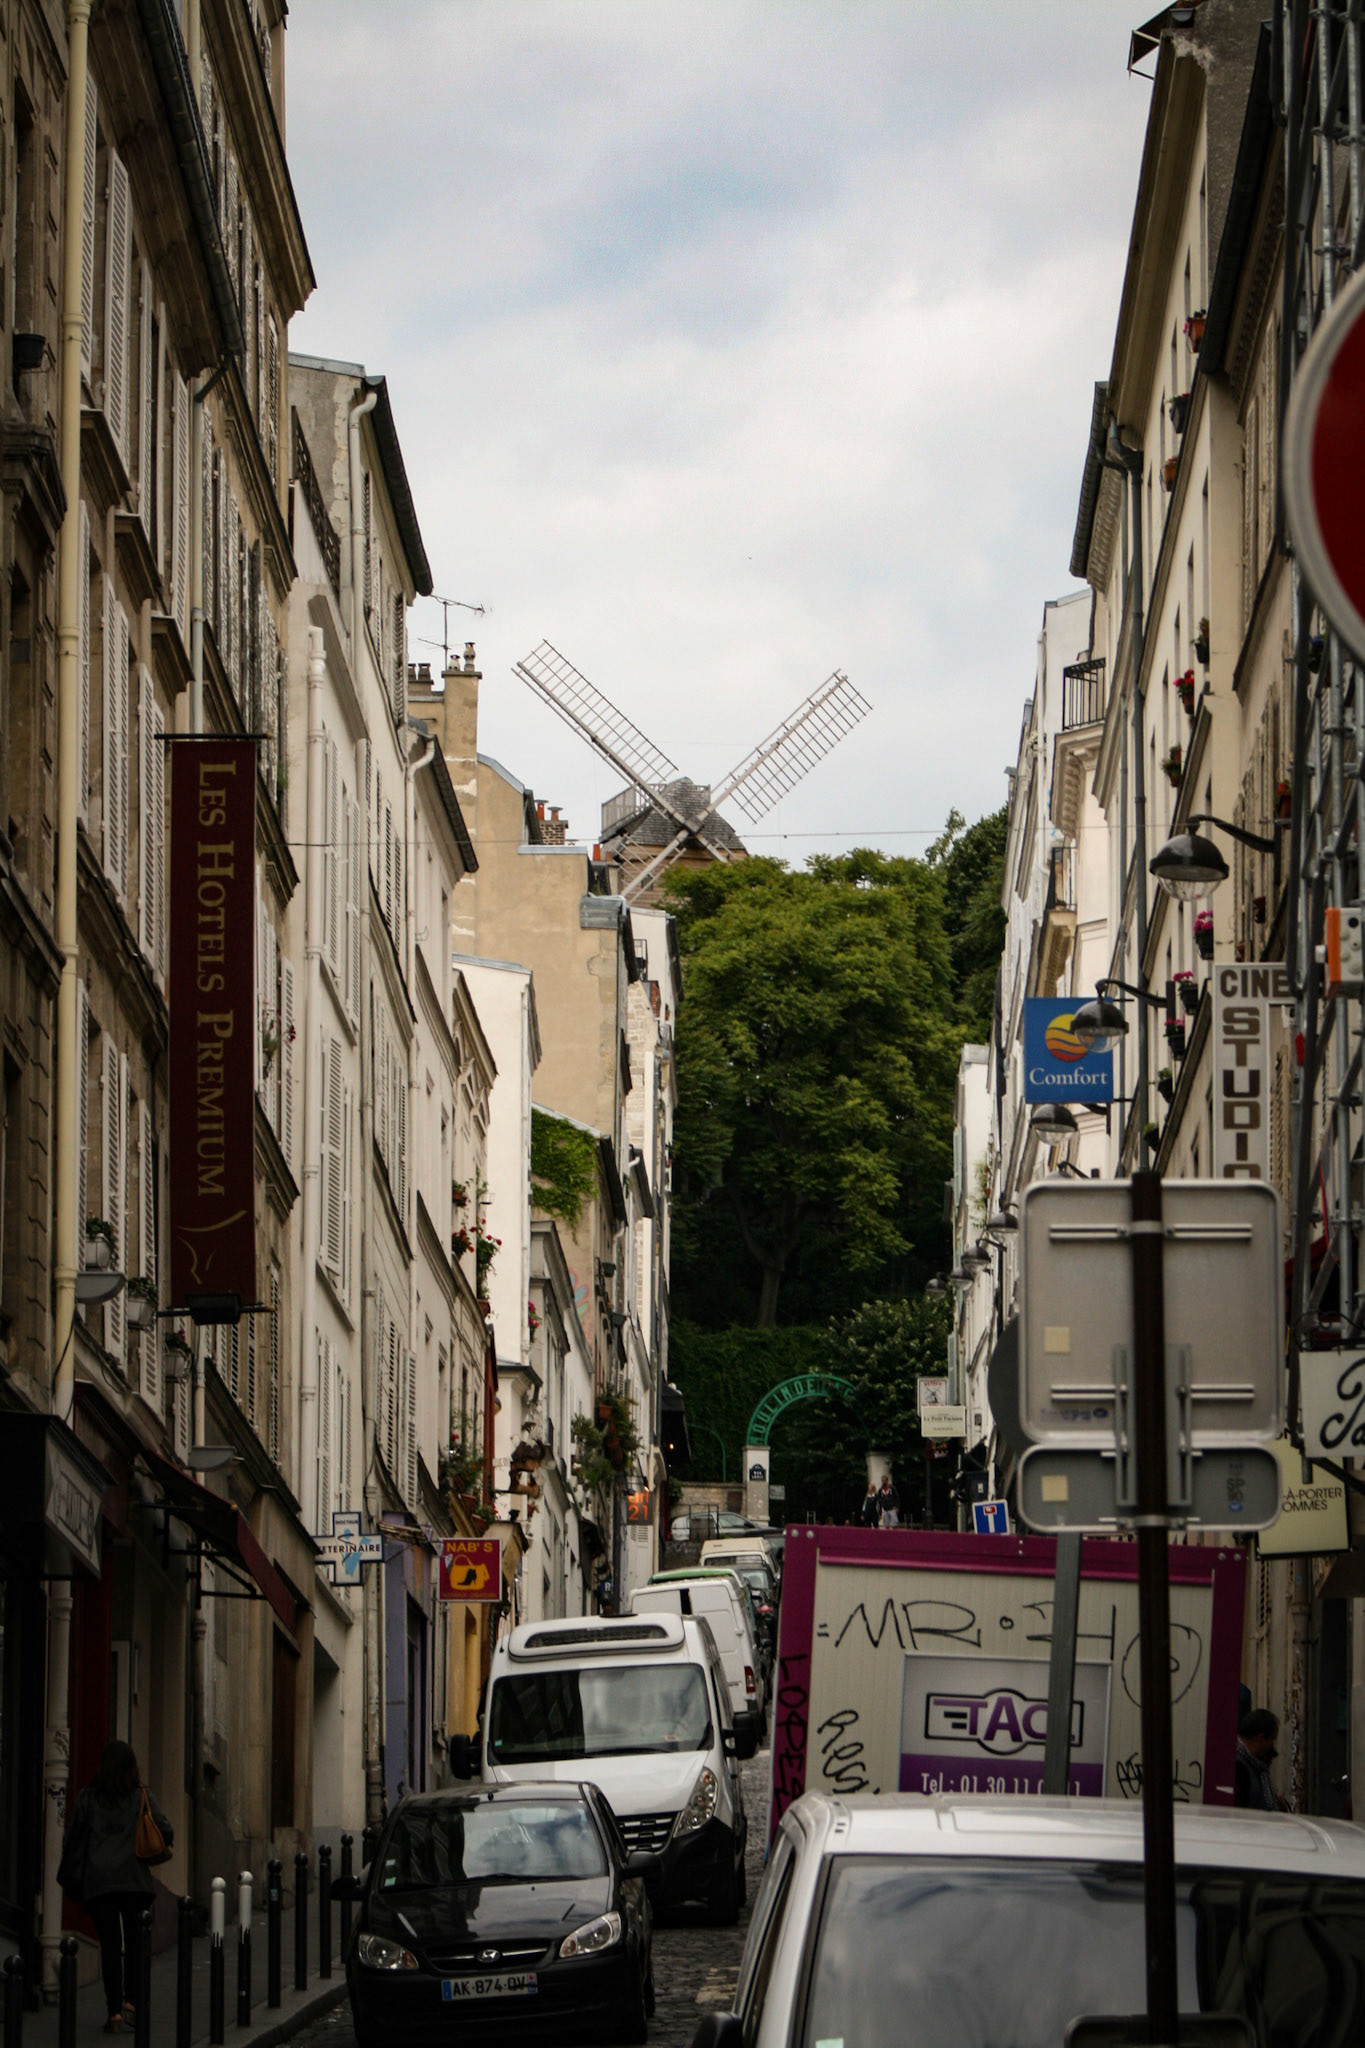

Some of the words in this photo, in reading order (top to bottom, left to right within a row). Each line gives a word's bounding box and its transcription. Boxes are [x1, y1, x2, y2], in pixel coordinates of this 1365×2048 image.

[196, 840, 235, 994] HOTELS
[1029, 1066, 1108, 1086] Comfort
[196, 1009, 235, 1198] PREMIUM
[628, 1504, 649, 1521] 21
[318, 1544, 381, 1554] ETERINAIRE
